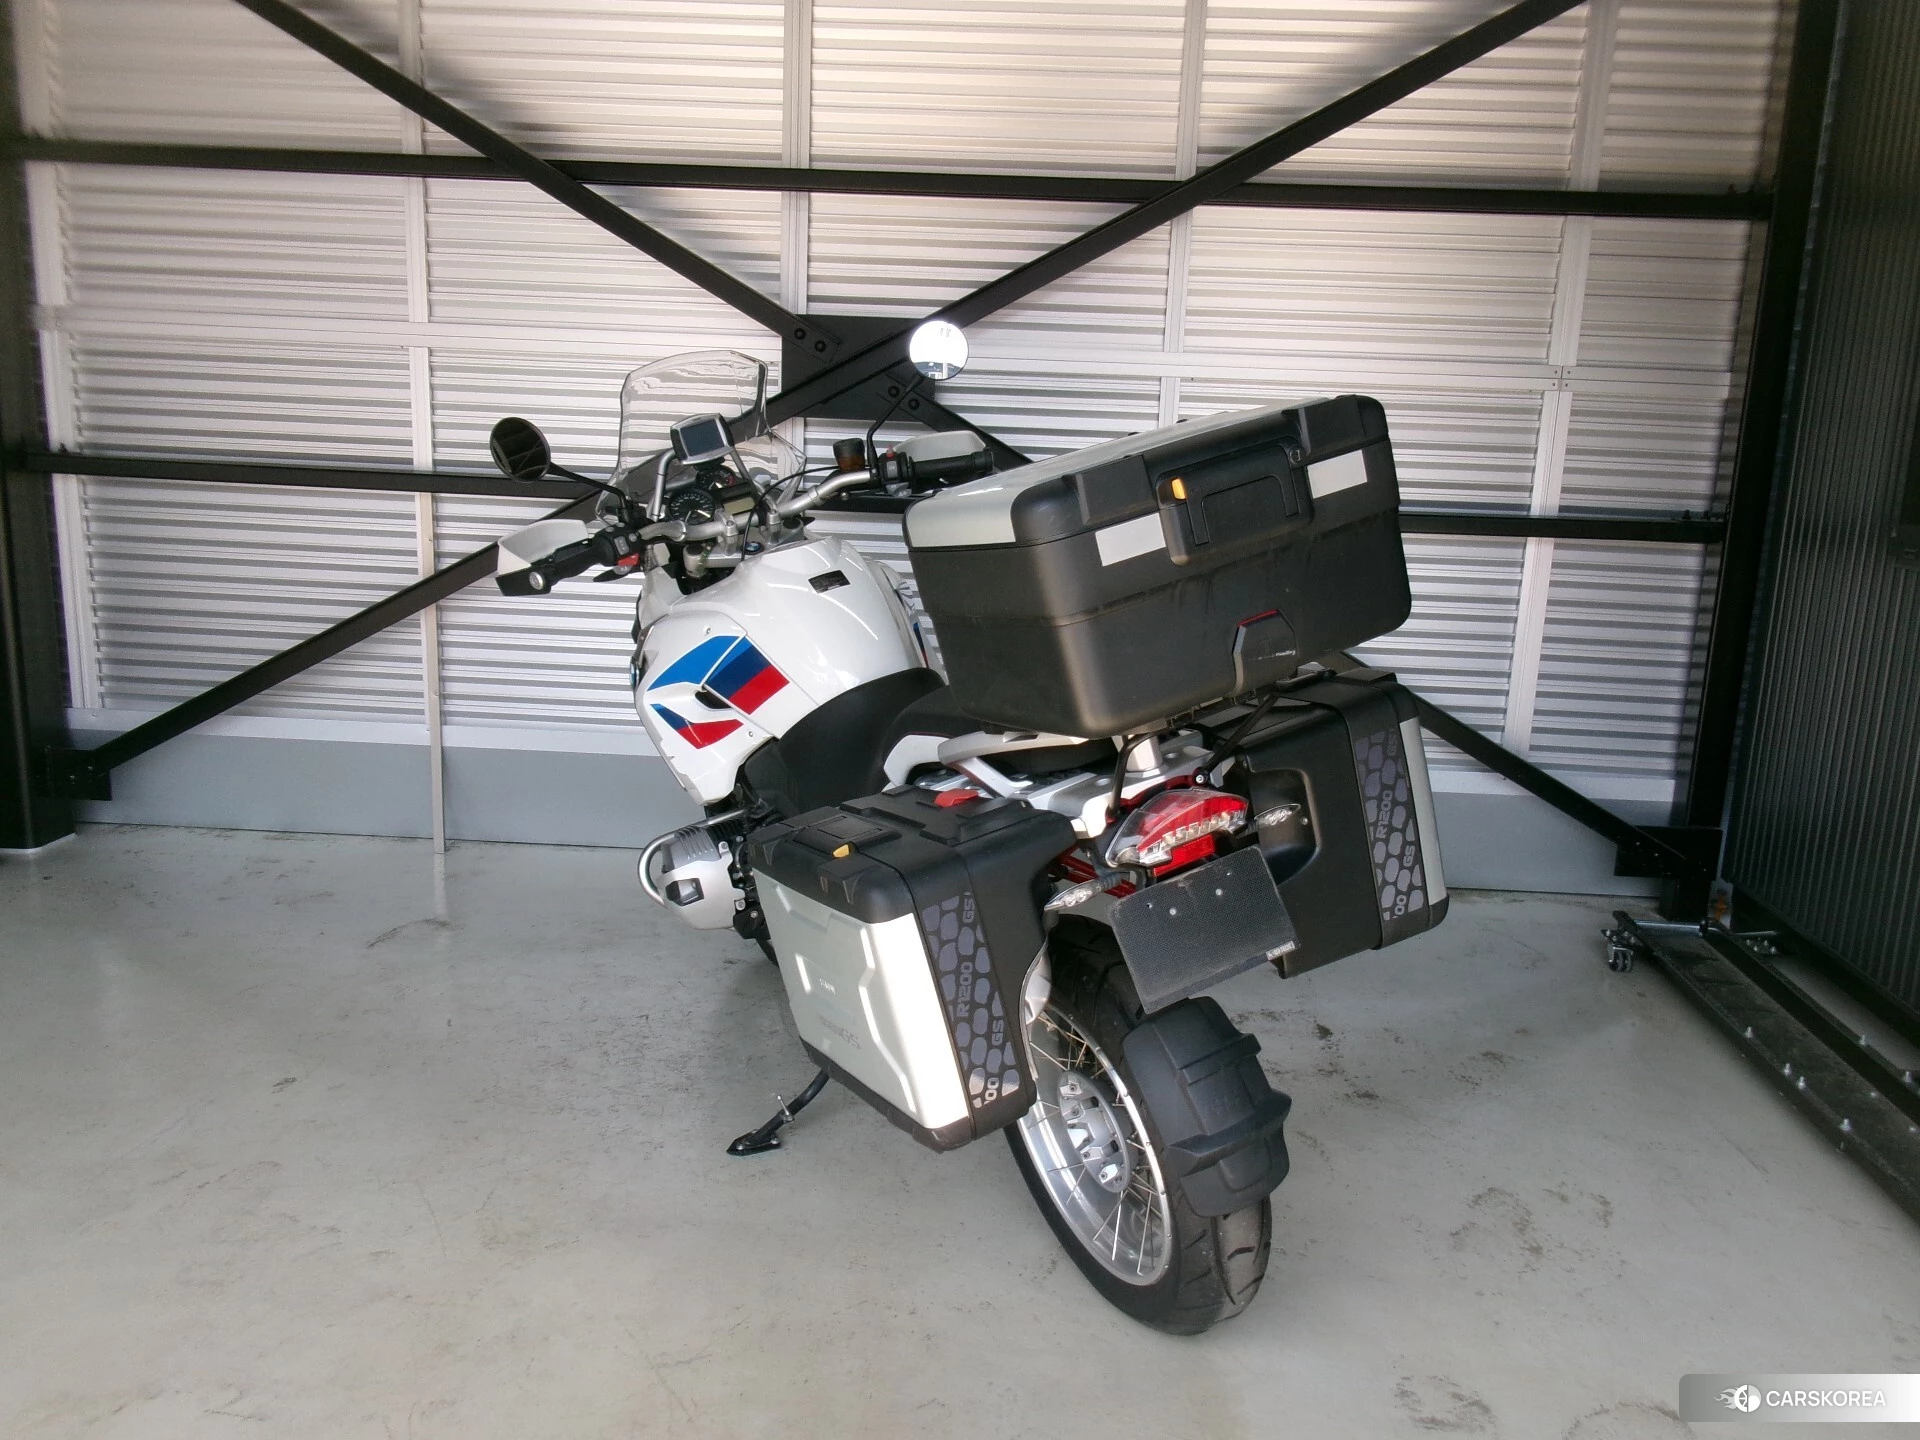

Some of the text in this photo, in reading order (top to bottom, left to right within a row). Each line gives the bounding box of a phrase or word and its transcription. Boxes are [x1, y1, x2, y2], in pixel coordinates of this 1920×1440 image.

[1376, 790, 1393, 839] R1200
[1403, 845, 1416, 867] GS
[962, 897, 975, 924] GS
[1392, 894, 1407, 919] 00
[956, 961, 974, 1018] R1200
[991, 1019, 1004, 1046] GS
[984, 1077, 1000, 1106] 00
